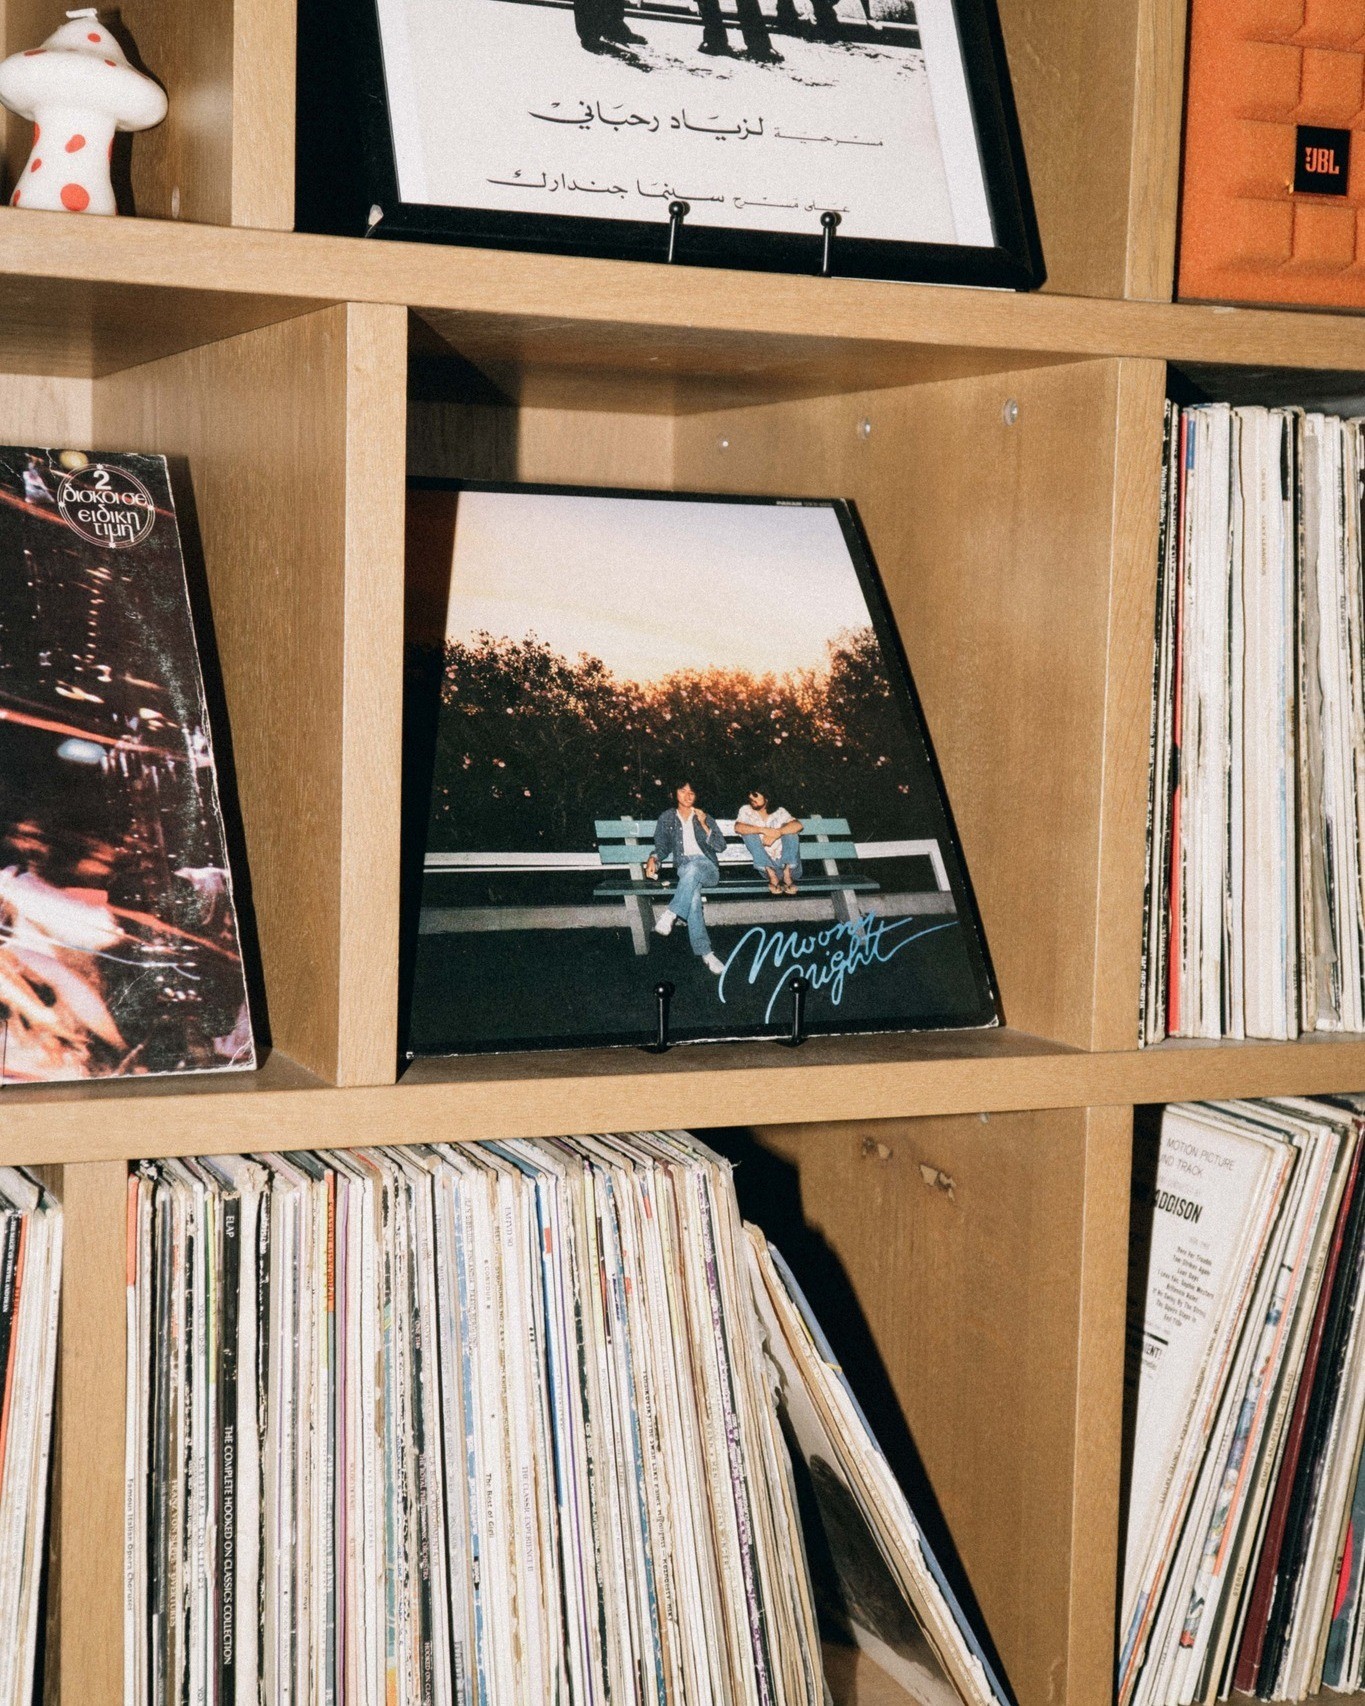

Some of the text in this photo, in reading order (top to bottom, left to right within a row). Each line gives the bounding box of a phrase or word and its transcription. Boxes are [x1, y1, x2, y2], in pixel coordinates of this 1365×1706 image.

[1305, 146, 1340, 175] JBL
[93, 470, 112, 490] 2
[1166, 1138, 1234, 1171] MOTION PICTURE
[1177, 1159, 1205, 1176] TRACK
[225, 1215, 234, 1237] ELAP
[484, 1472, 492, 1486] The
[521, 1466, 529, 1480] THE
[485, 1490, 493, 1507] Best
[126, 1514, 134, 1541] Italian
[222, 1425, 233, 1665] THE COMPLETE HOOKED ON CLASSICS COLLECTION
[523, 1516, 533, 1564] EXPERIENCE
[125, 1543, 133, 1569] Opera
[1232, 1565, 1245, 1596] STEREO
[424, 1671, 430, 1681] ON
